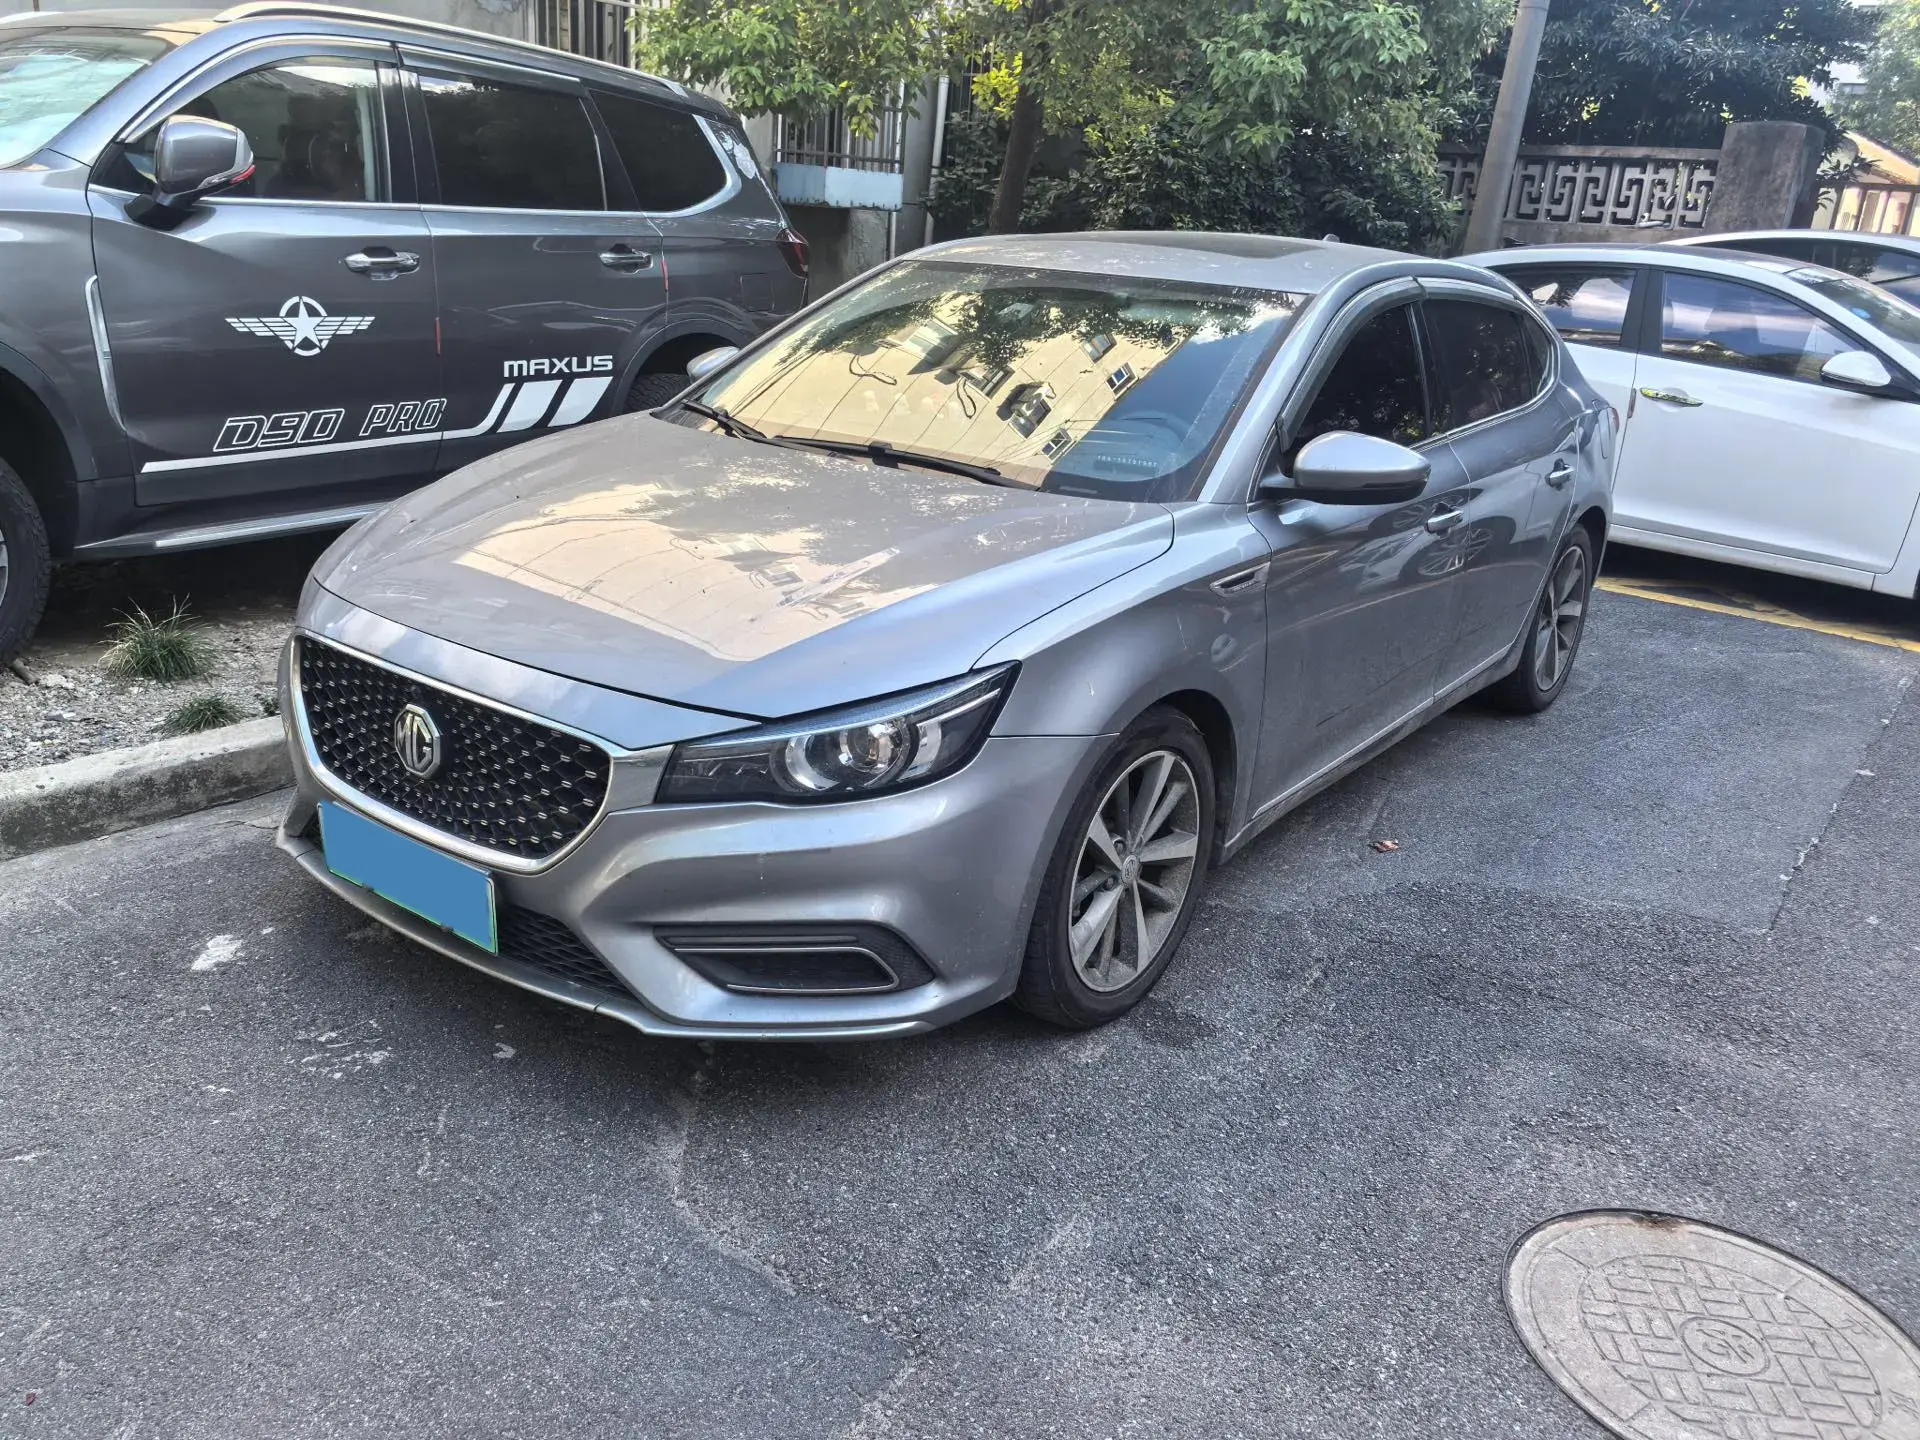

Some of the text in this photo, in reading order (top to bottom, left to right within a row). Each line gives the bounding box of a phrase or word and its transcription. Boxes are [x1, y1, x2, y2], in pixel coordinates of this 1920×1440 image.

[503, 355, 613, 377] MAXUS
[213, 398, 447, 452] D90 PRO
[396, 709, 434, 772] MG
